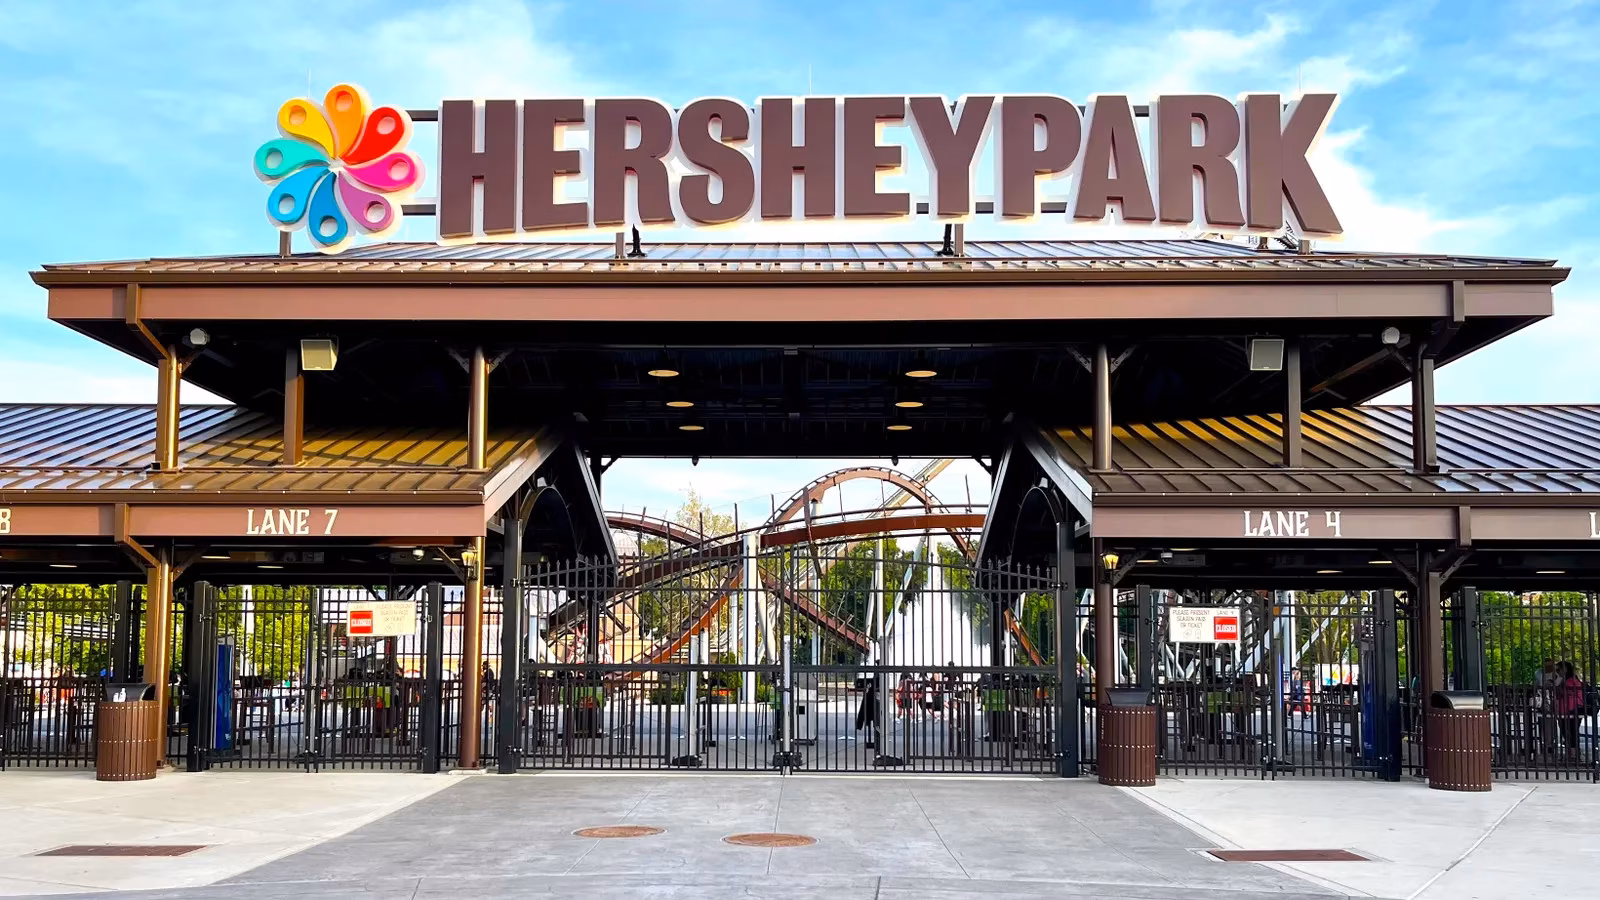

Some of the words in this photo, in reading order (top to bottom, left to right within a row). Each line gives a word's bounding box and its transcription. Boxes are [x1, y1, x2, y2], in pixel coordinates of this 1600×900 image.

[440, 93, 1344, 238] HERSHEYPARK
[247, 509, 310, 535] LANE
[324, 509, 339, 535] 7
[1243, 511, 1309, 537] LANE
[1325, 511, 1342, 537] 4
